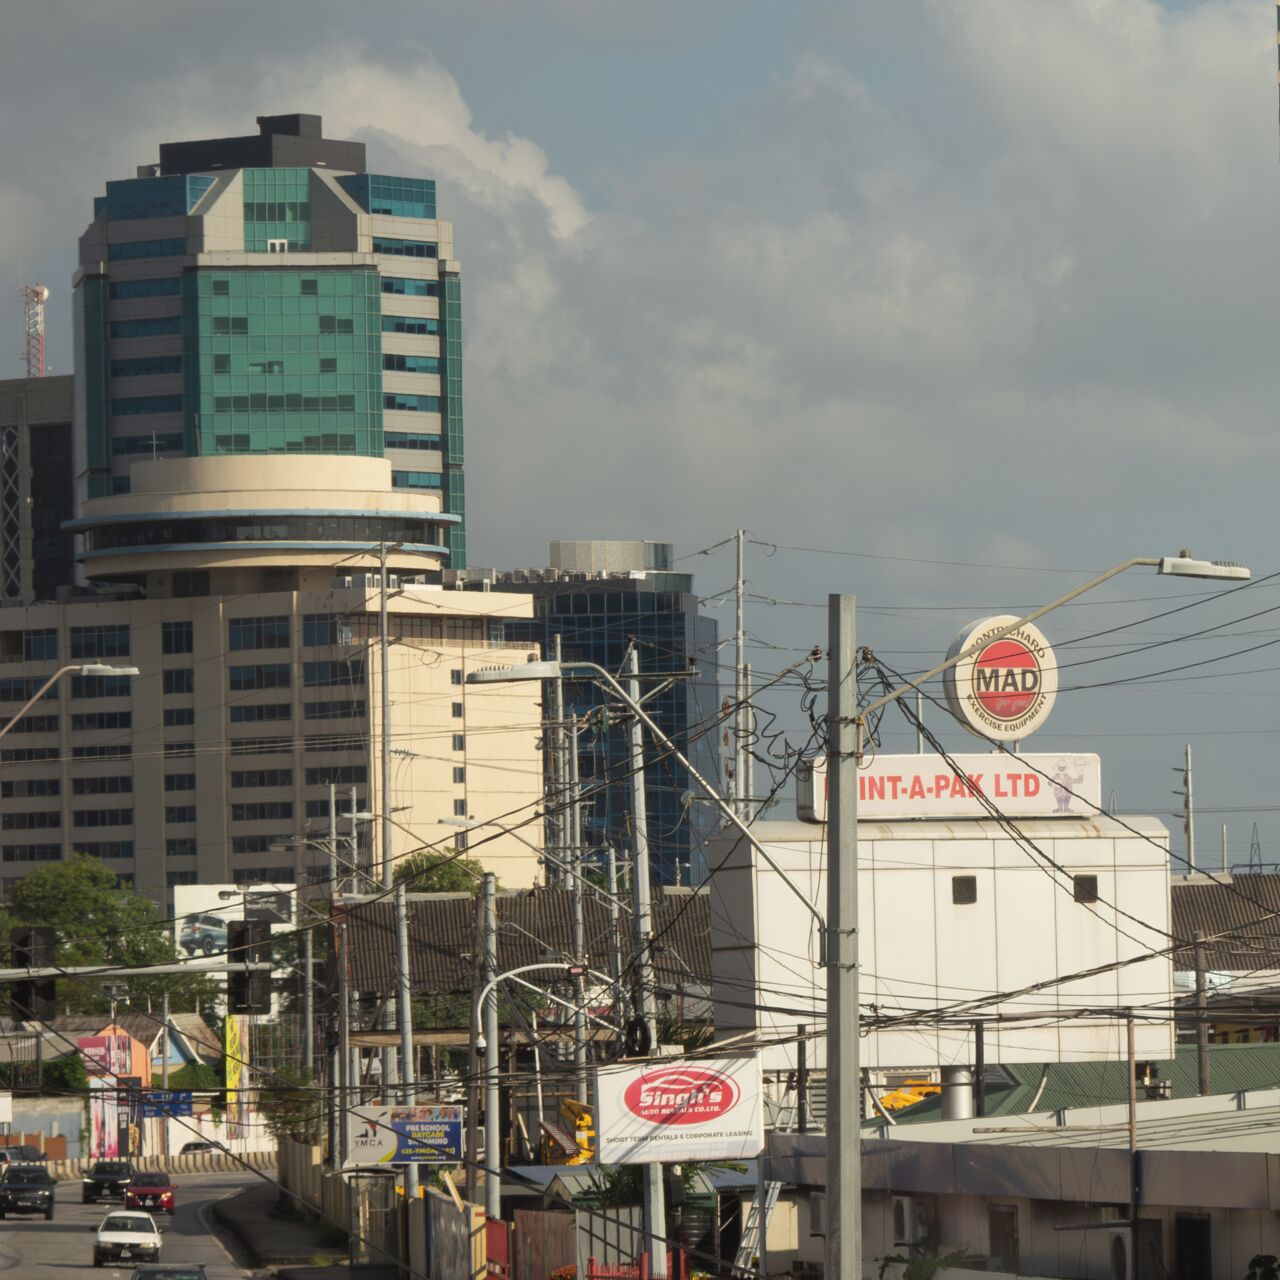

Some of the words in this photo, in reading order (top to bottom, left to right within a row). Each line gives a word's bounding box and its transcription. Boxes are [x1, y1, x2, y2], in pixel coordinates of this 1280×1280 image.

[976, 668, 1039, 692] MAD
[966, 694, 1003, 731] EXERCISE
[1004, 693, 1047, 732] EQUIPMENT
[994, 773, 1041, 797] LTD
[640, 1085, 723, 1109] Singh's
[640, 1107, 660, 1116] AUTO
[660, 1106, 692, 1115] RENTALS
[354, 1139, 384, 1147] YMCA
[606, 1135, 629, 1144] SHORT
[630, 1135, 649, 1143] TERM
[650, 1134, 679, 1142] RENTALS
[685, 1131, 724, 1140] CORPORATE
[725, 1129, 753, 1138] LEASING
